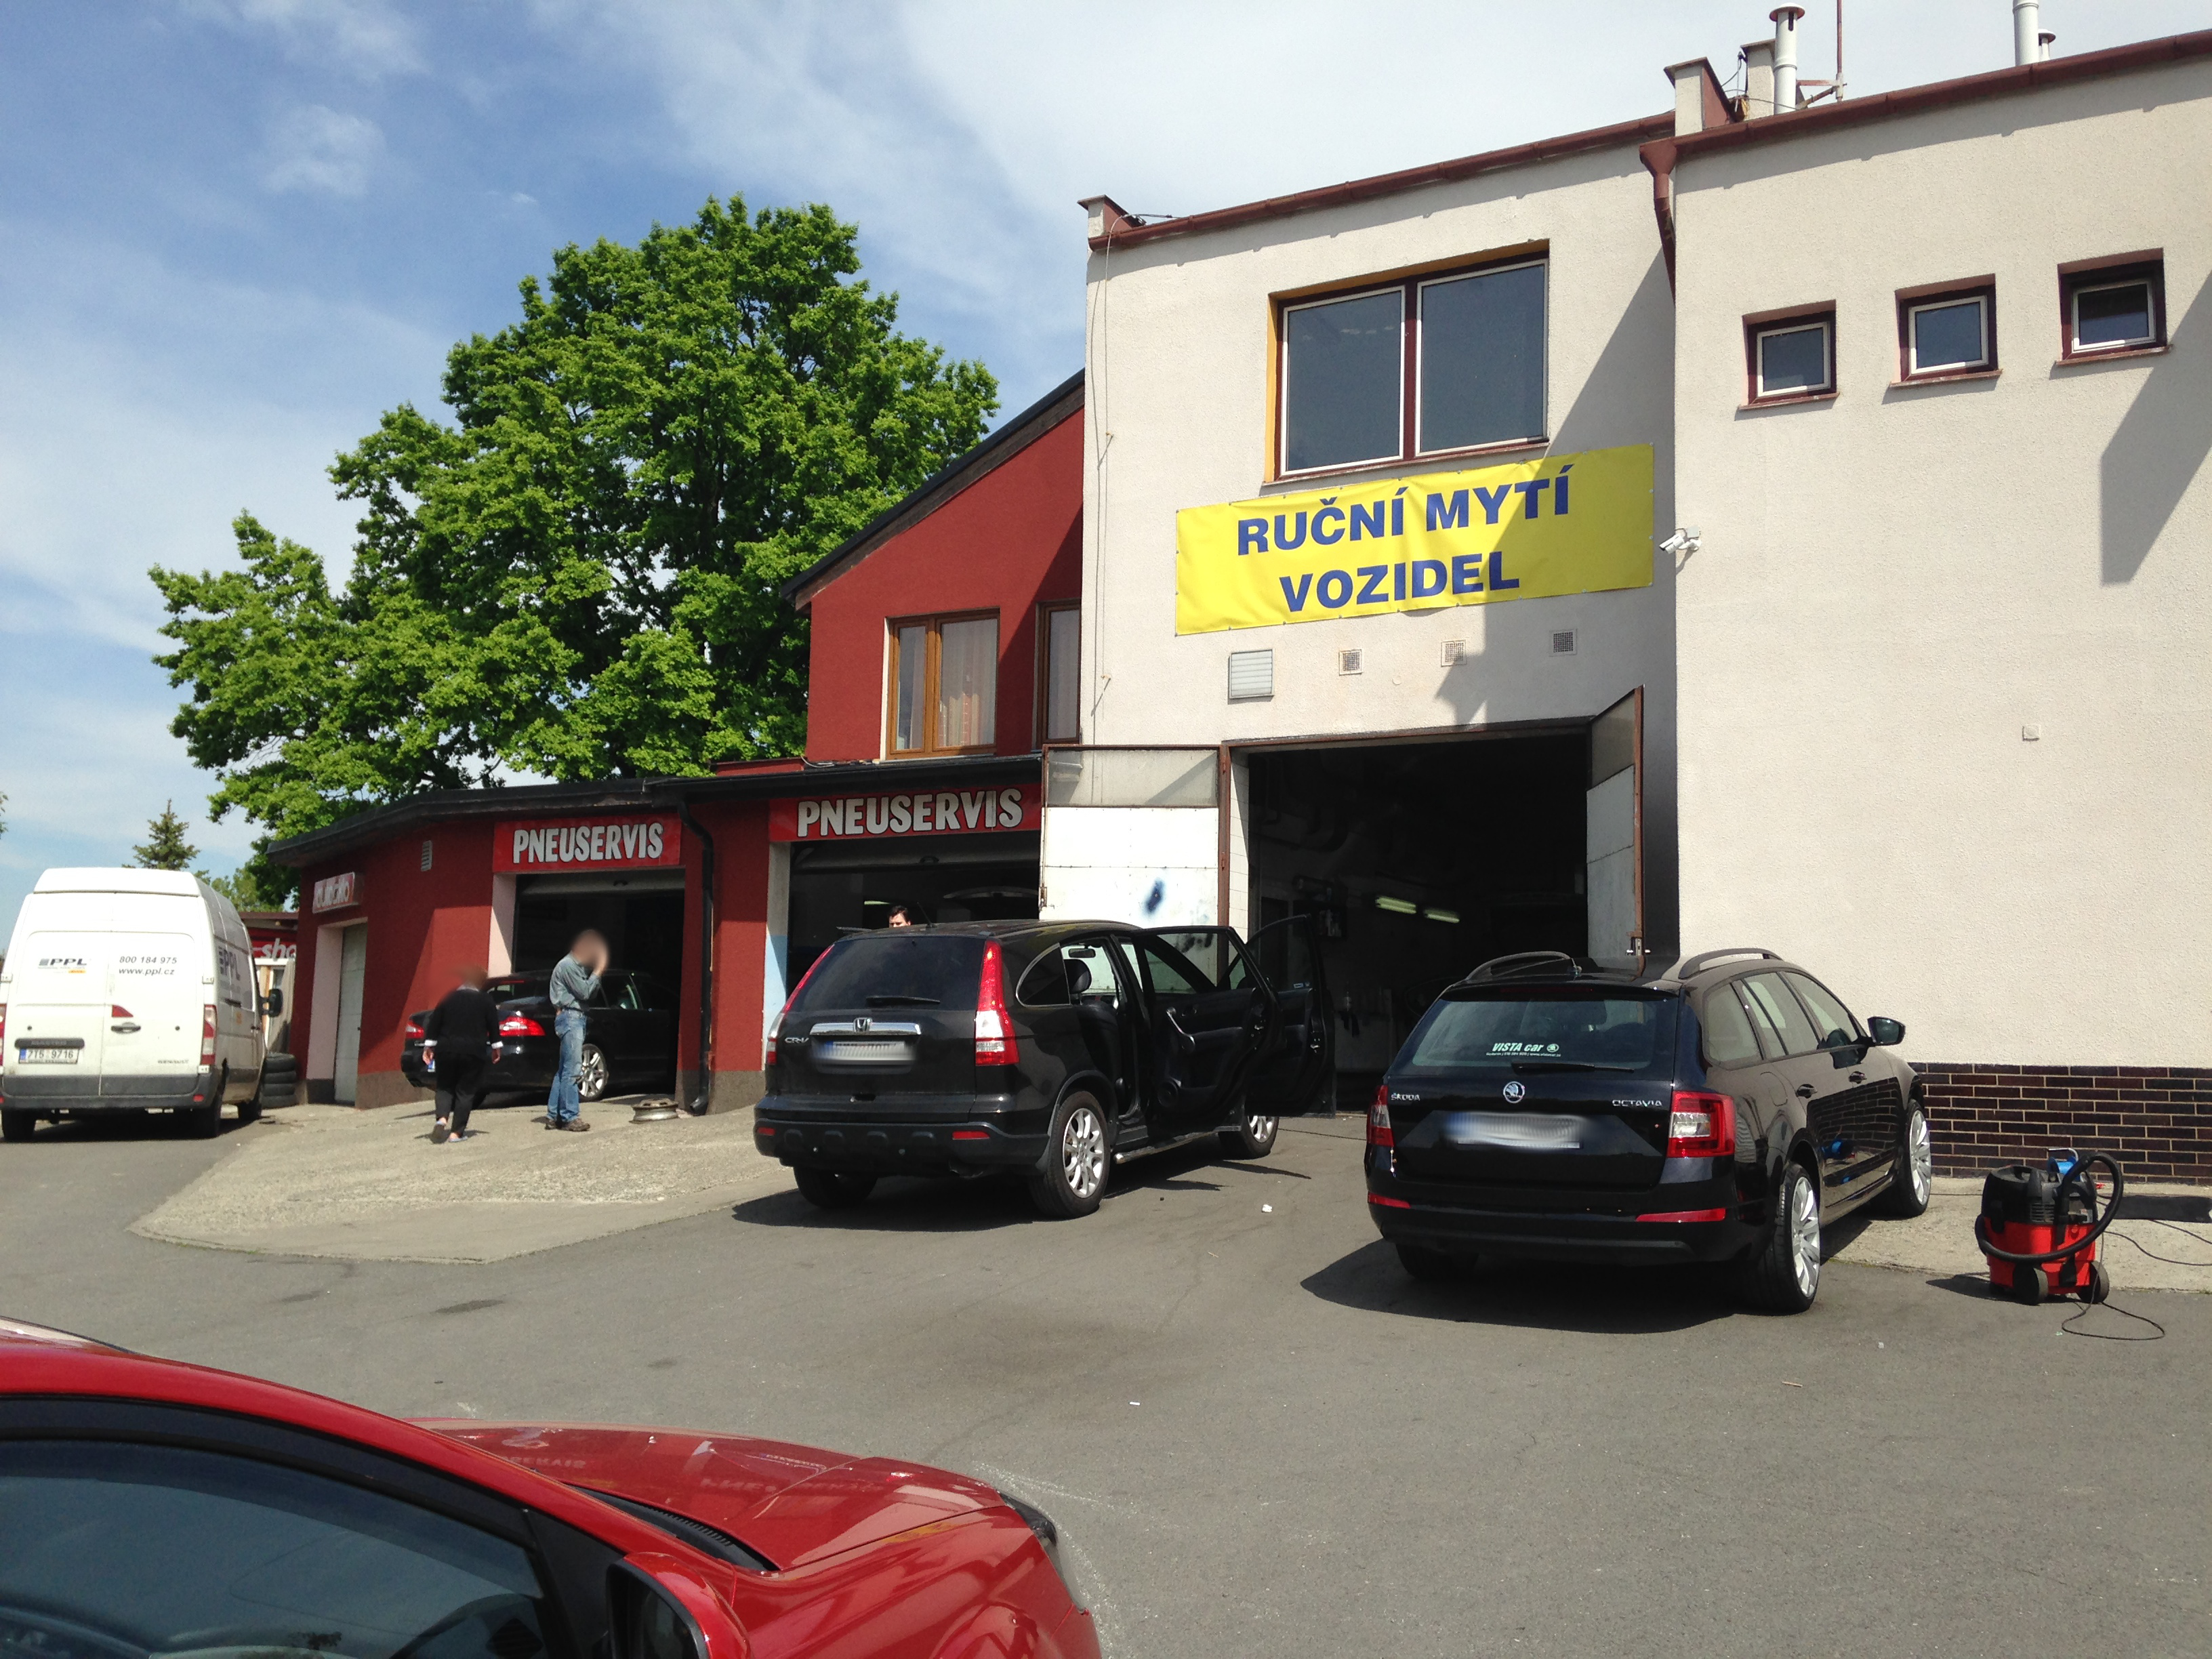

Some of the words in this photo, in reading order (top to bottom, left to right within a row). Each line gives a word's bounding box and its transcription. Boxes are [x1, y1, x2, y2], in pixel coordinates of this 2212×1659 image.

[1237, 486, 1408, 556] RUČNÍ
[1426, 464, 1574, 533] MYTÍ
[1279, 551, 1519, 611] VOZIDEL
[797, 788, 1023, 838] PNEUSERVIS
[512, 822, 663, 864] PNEUSERVIS
[49, 958, 87, 966] PPL
[119, 968, 175, 976] www.ppl.cz
[1492, 1042, 1523, 1052] VISTA
[1524, 1044, 1544, 1052] car
[52, 1049, 74, 1059] 9716
[1612, 1099, 1663, 1107] OCTAVIA
